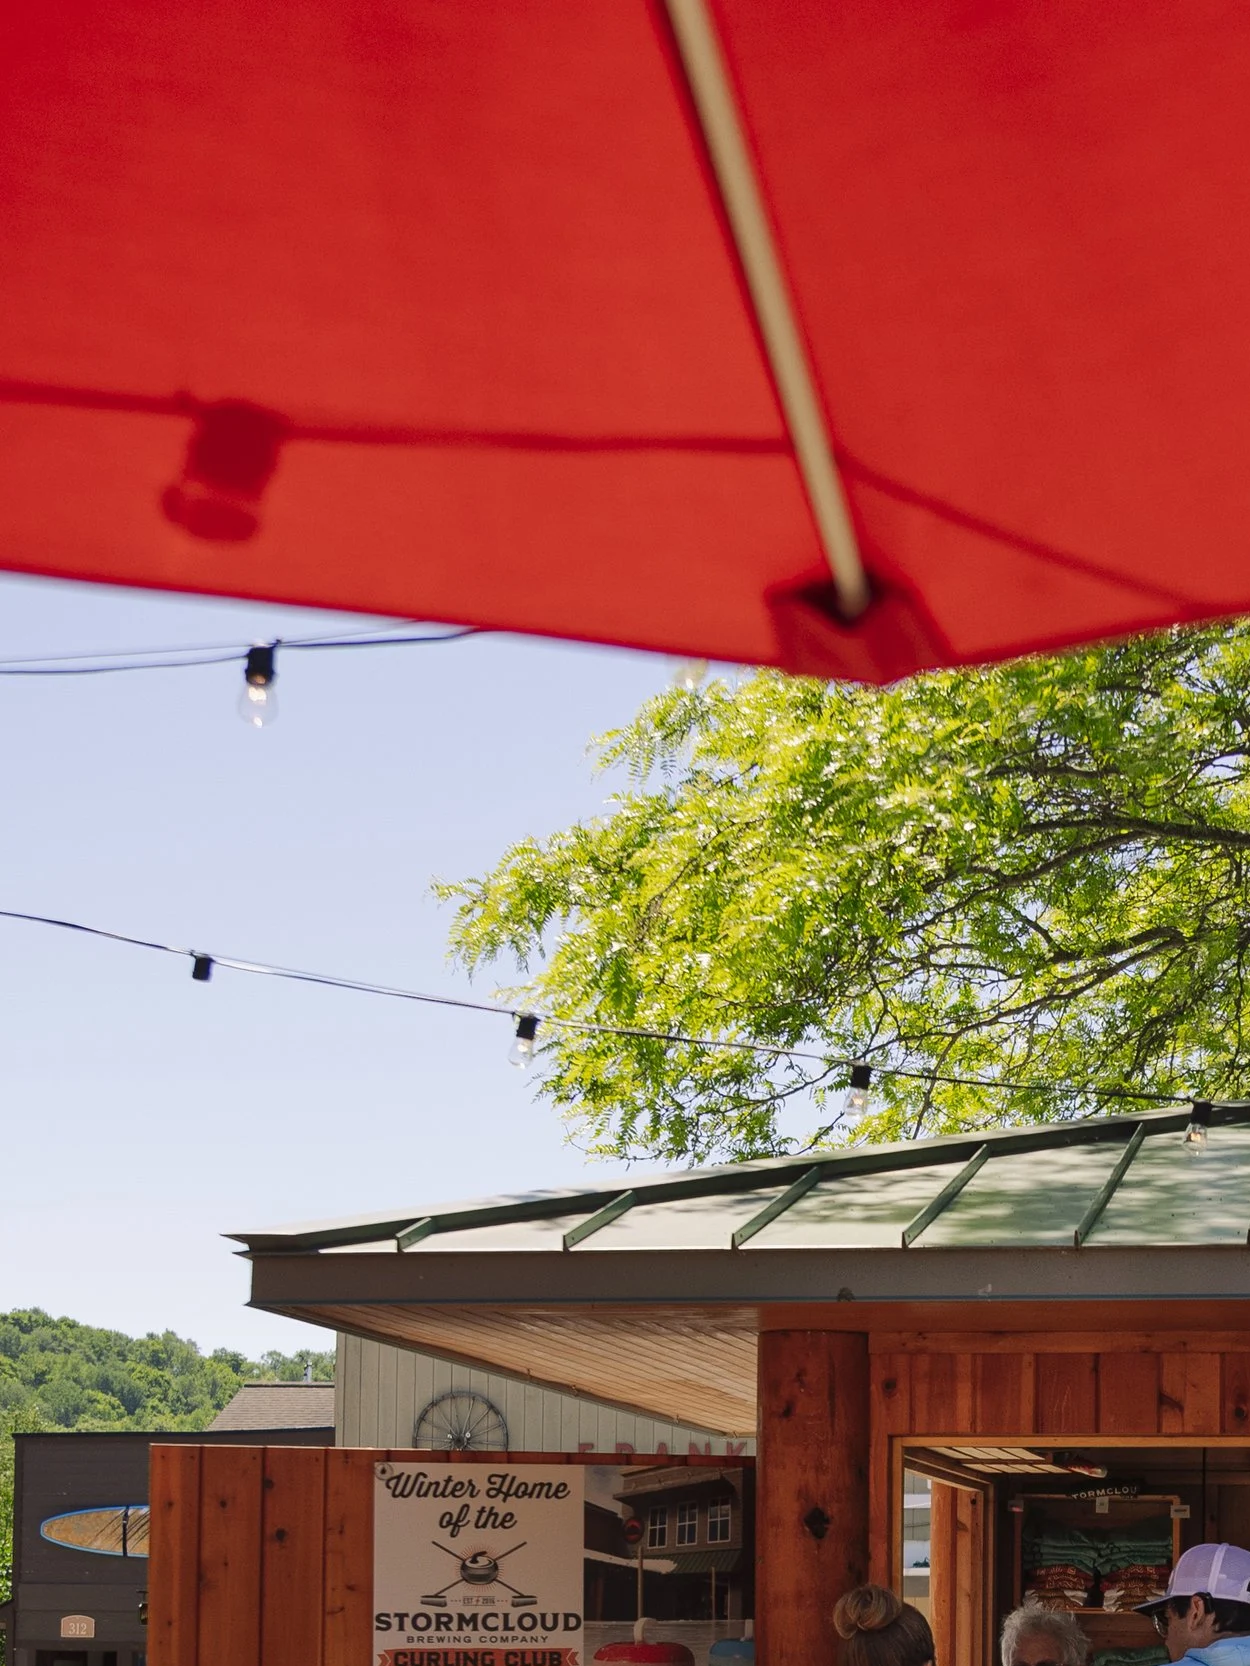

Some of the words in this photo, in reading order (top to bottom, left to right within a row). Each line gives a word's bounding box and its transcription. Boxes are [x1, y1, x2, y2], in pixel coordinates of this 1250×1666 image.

[385, 1472, 480, 1499] Winter
[486, 1473, 571, 1503] Home
[438, 1504, 470, 1538] of
[473, 1506, 518, 1530] the
[69, 1622, 87, 1635] 312
[375, 1612, 583, 1632] STORMCLOUD
[406, 1635, 473, 1644] BREWING
[479, 1635, 549, 1643] COMPANY
